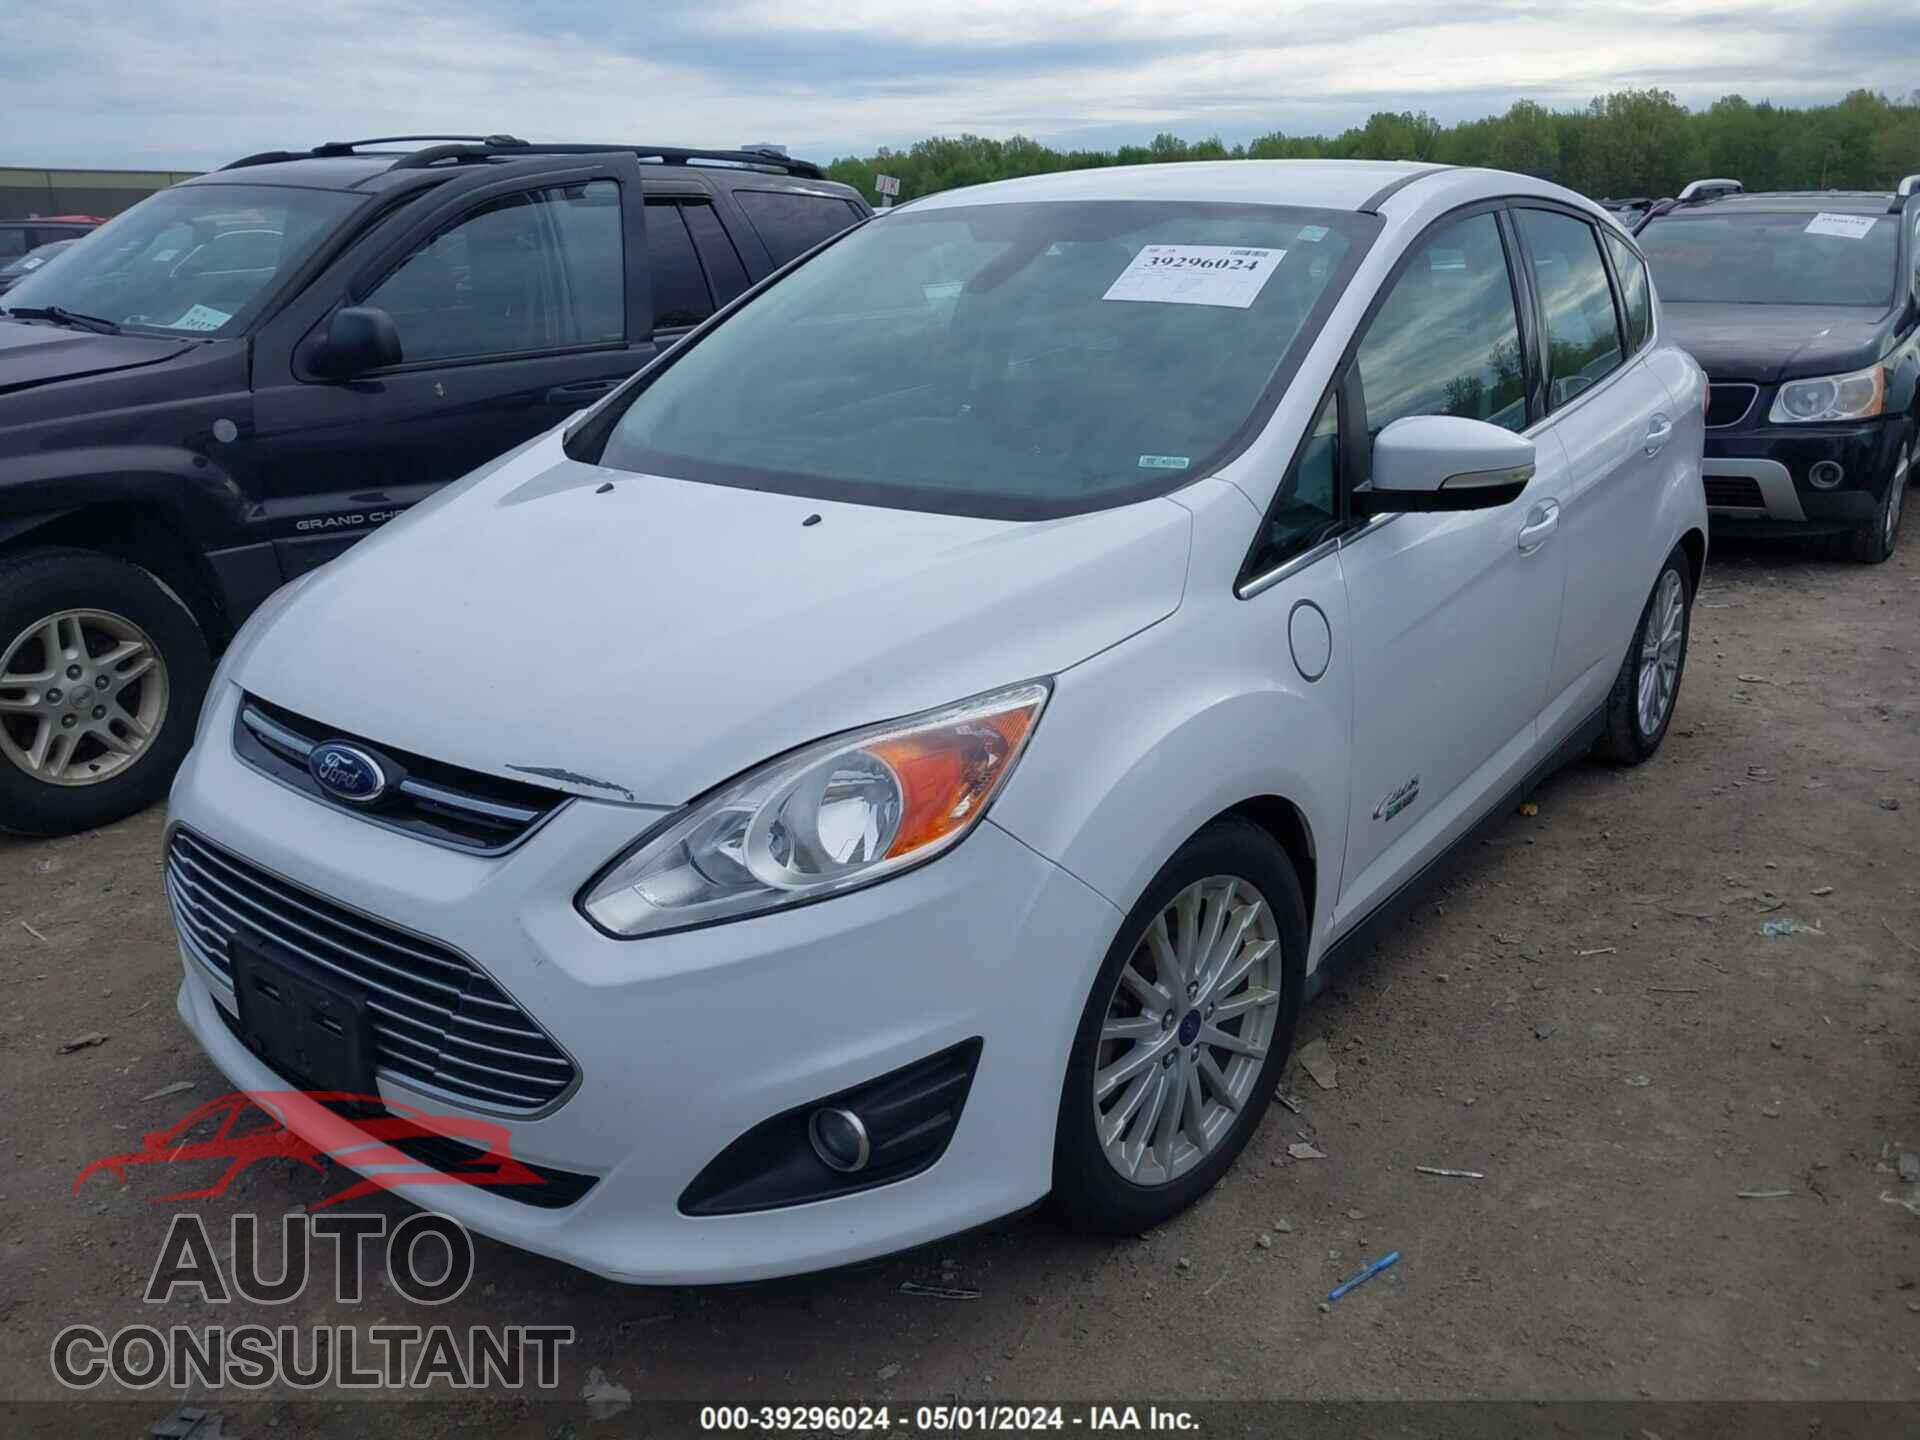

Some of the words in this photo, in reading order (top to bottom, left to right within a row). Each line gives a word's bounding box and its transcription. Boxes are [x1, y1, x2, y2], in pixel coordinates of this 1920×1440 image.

[1144, 256, 1259, 271] 39296024
[296, 514, 364, 530] GRAND
[319, 752, 362, 788] Ford
